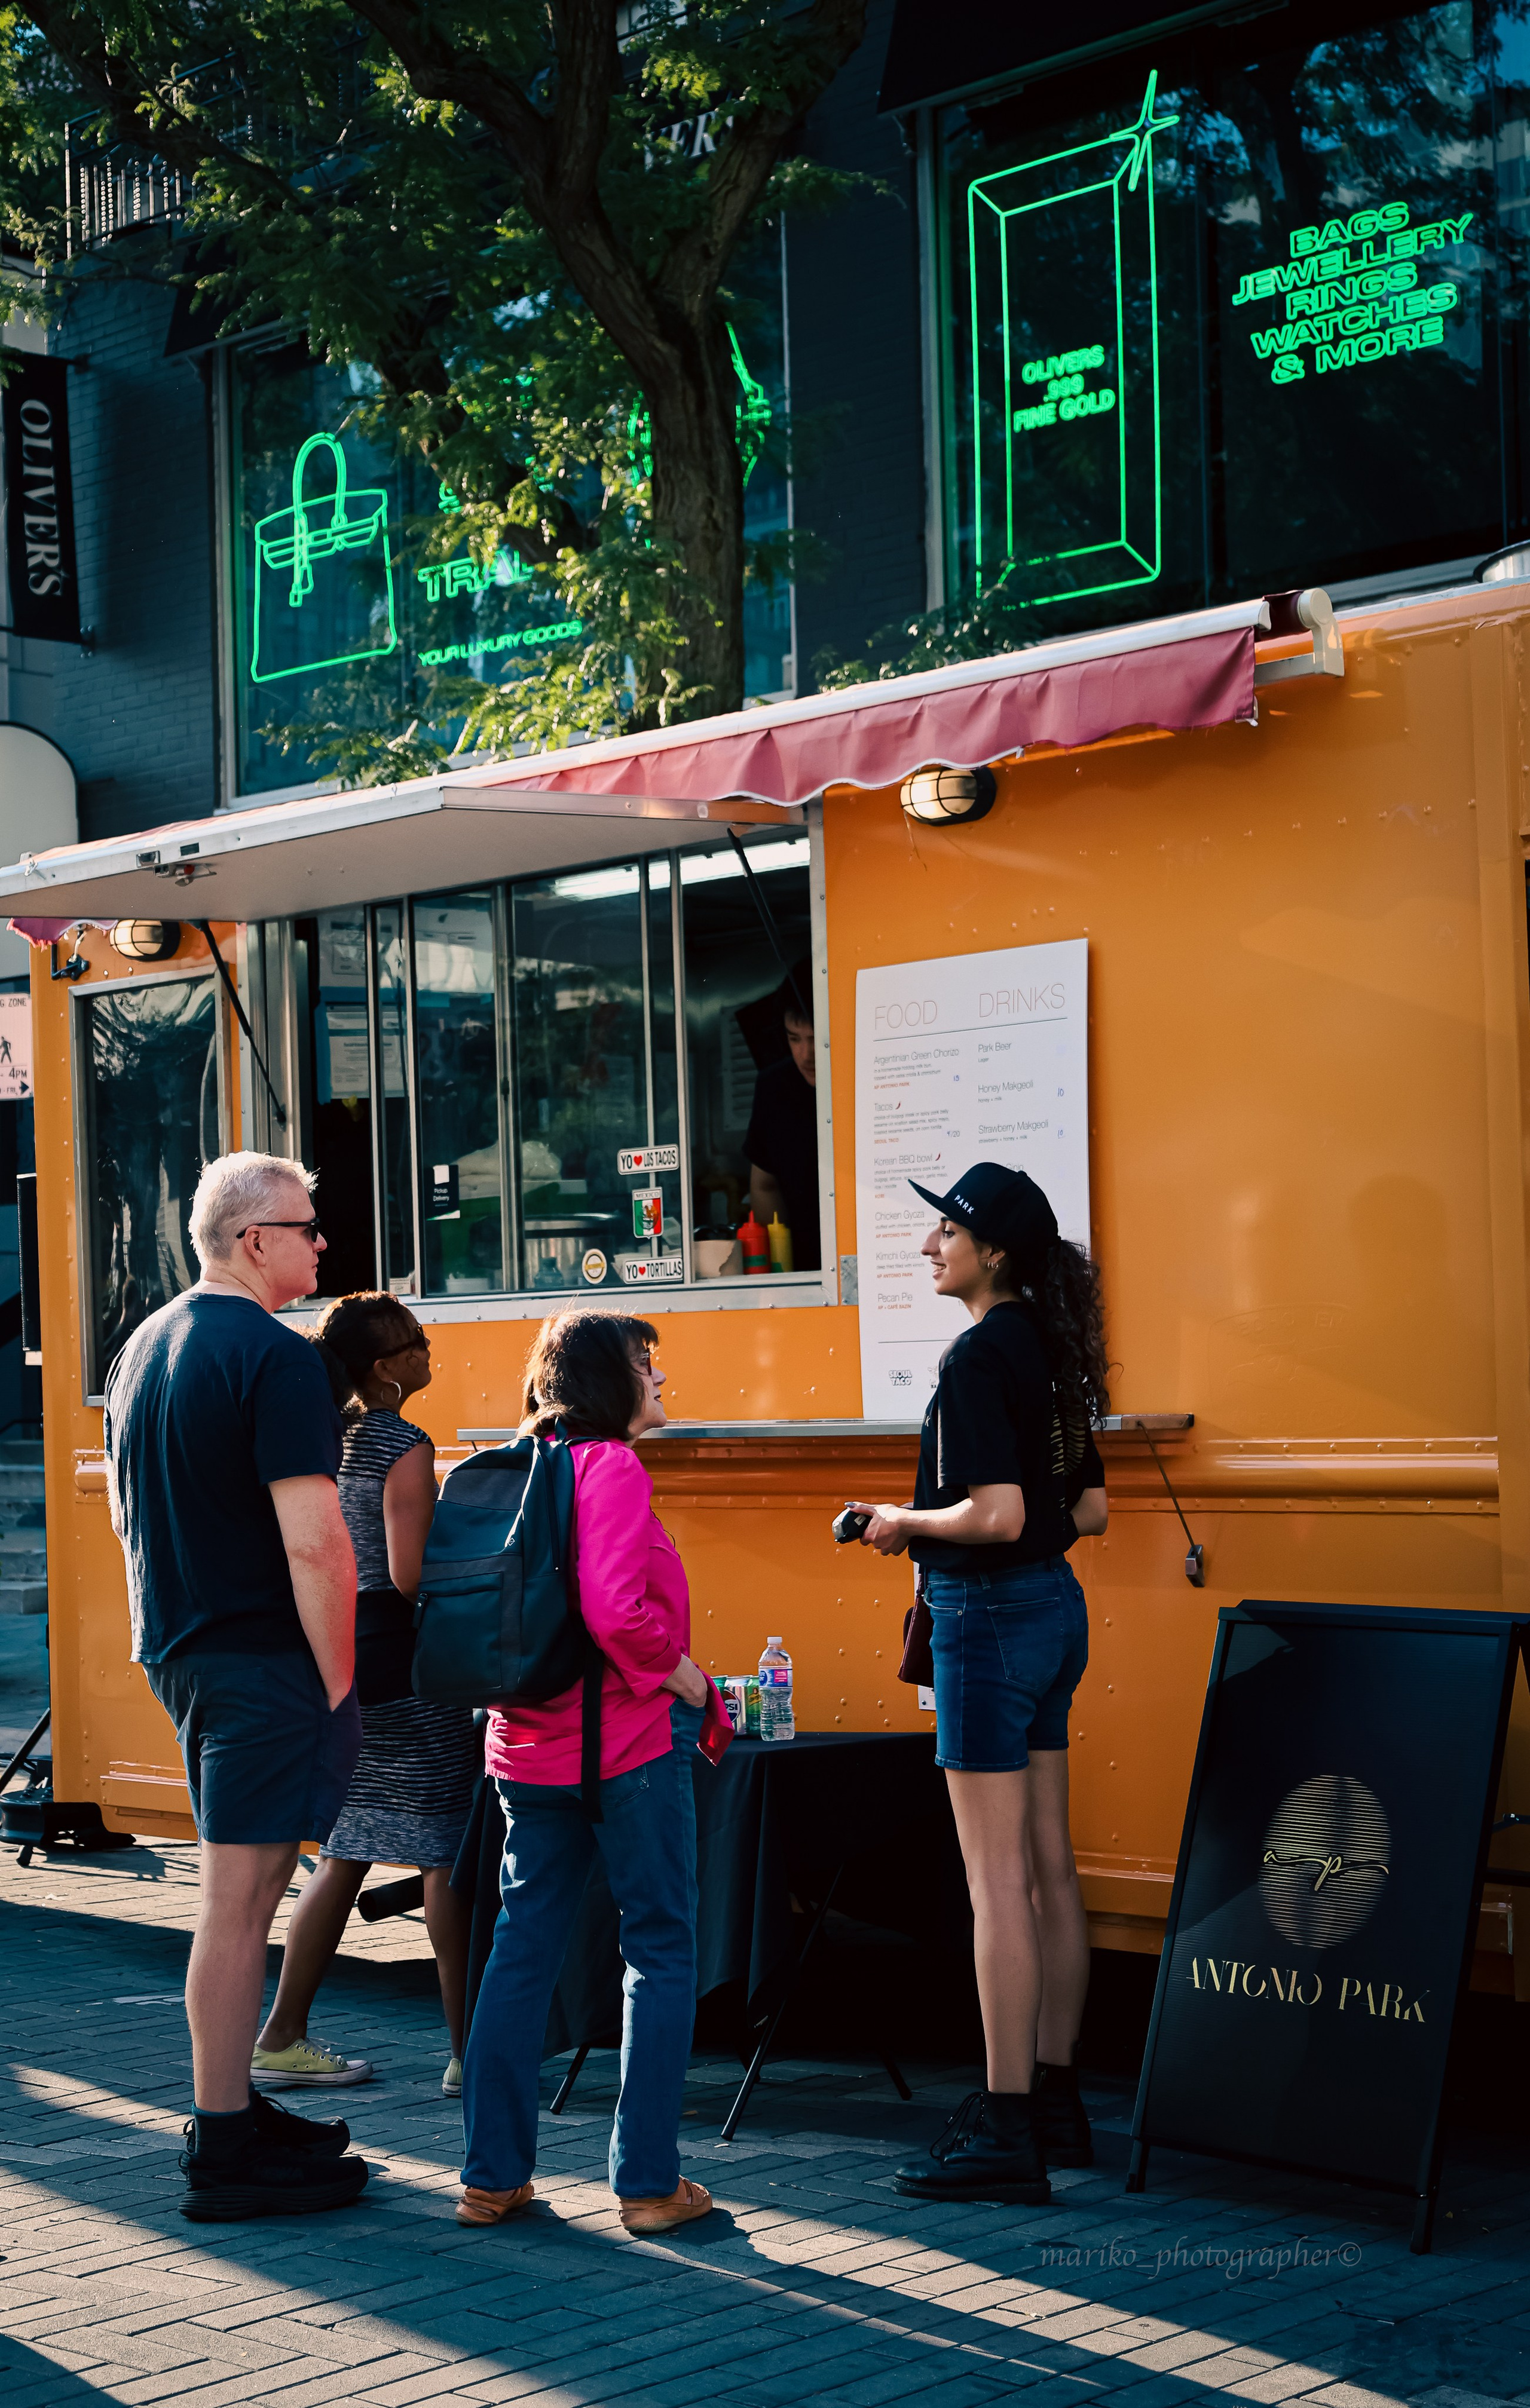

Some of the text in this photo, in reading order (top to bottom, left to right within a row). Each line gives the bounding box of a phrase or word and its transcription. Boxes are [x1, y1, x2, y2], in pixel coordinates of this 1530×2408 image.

[1290, 201, 1409, 258] BAGS
[1232, 213, 1474, 306] JEWELLERY
[1286, 262, 1418, 320] RINGS
[1250, 283, 1458, 359] WATCHES
[1271, 315, 1444, 384] & MORE
[1022, 344, 1104, 385] OLIVERS
[1013, 388, 1116, 433] FINE GOLD
[418, 620, 582, 666] YOUR LUXURY GOODS
[8, 998, 27, 1007] ZONE
[875, 983, 1065, 1030] FOOD DRINKS
[978, 1042, 1012, 1052] Park Beer
[874, 1049, 959, 1065] Argentinian Green Chorizo
[978, 1080, 1033, 1093] Honey Makgeoli
[874, 1103, 893, 1111] Tacos
[978, 1119, 1049, 1134] Strawberry Makgeoli
[621, 1150, 676, 1170] YO LOS TACOS
[899, 1154, 915, 1164] BBQ
[916, 1154, 932, 1163] bowl
[954, 1194, 974, 1214] PARK
[875, 1210, 925, 1221] Chicken Gyoza
[876, 1250, 921, 1261] Kimchi Gyoza
[626, 1261, 681, 1279] YO TORTILLAS
[877, 1292, 913, 1303] Pecan Pie
[889, 1370, 913, 1378] SEOUL
[891, 1377, 911, 1386] TACO
[1186, 1957, 1431, 2023] ANTONIO PARK
